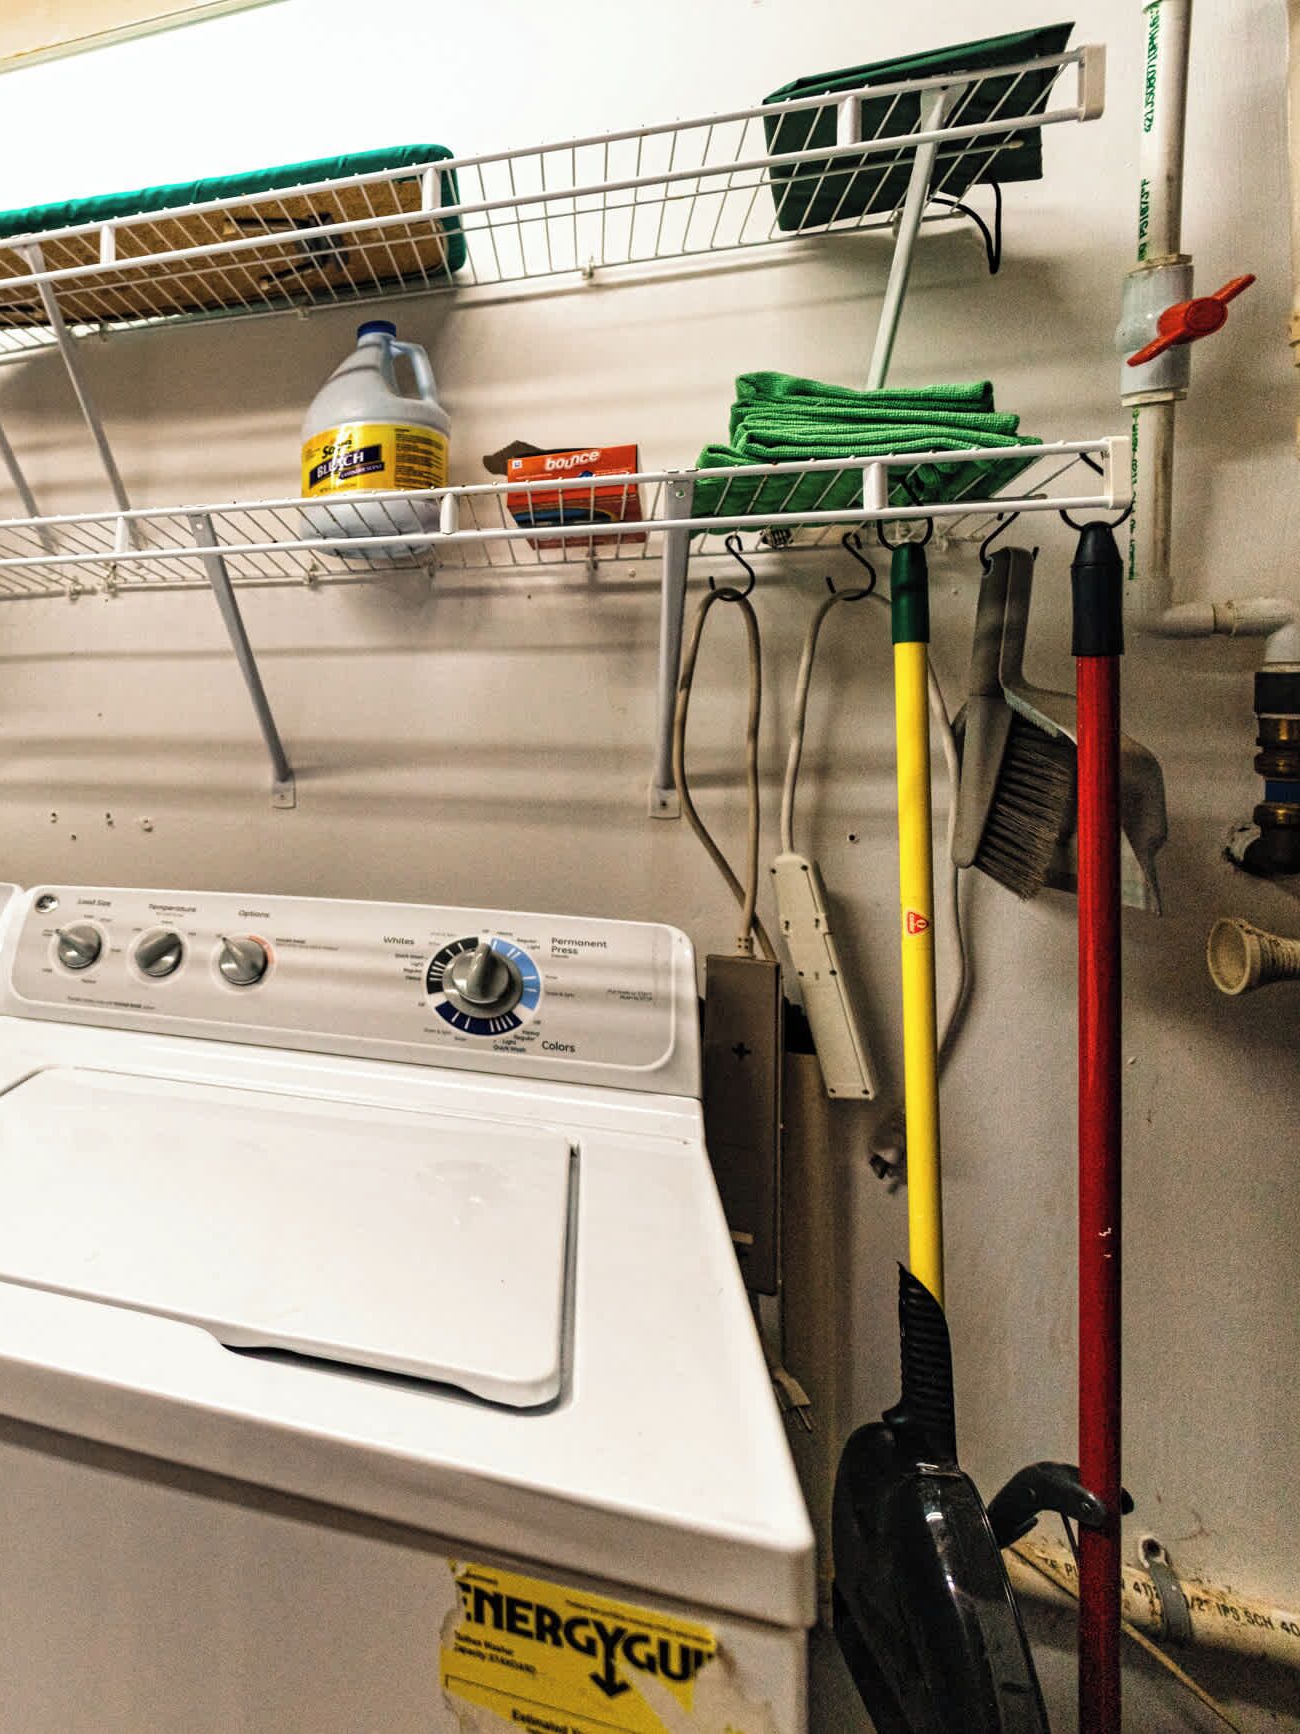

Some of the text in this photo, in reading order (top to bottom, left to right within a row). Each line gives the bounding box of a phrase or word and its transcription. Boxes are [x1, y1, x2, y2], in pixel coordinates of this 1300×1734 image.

[545, 450, 600, 470] bounce
[383, 936, 415, 945] Whites
[551, 937, 607, 948] Permanent
[551, 946, 578, 954] Press
[542, 1040, 576, 1053] Colors
[1244, 1608, 1275, 1631] SCH
[1280, 1620, 1300, 1638] 40
